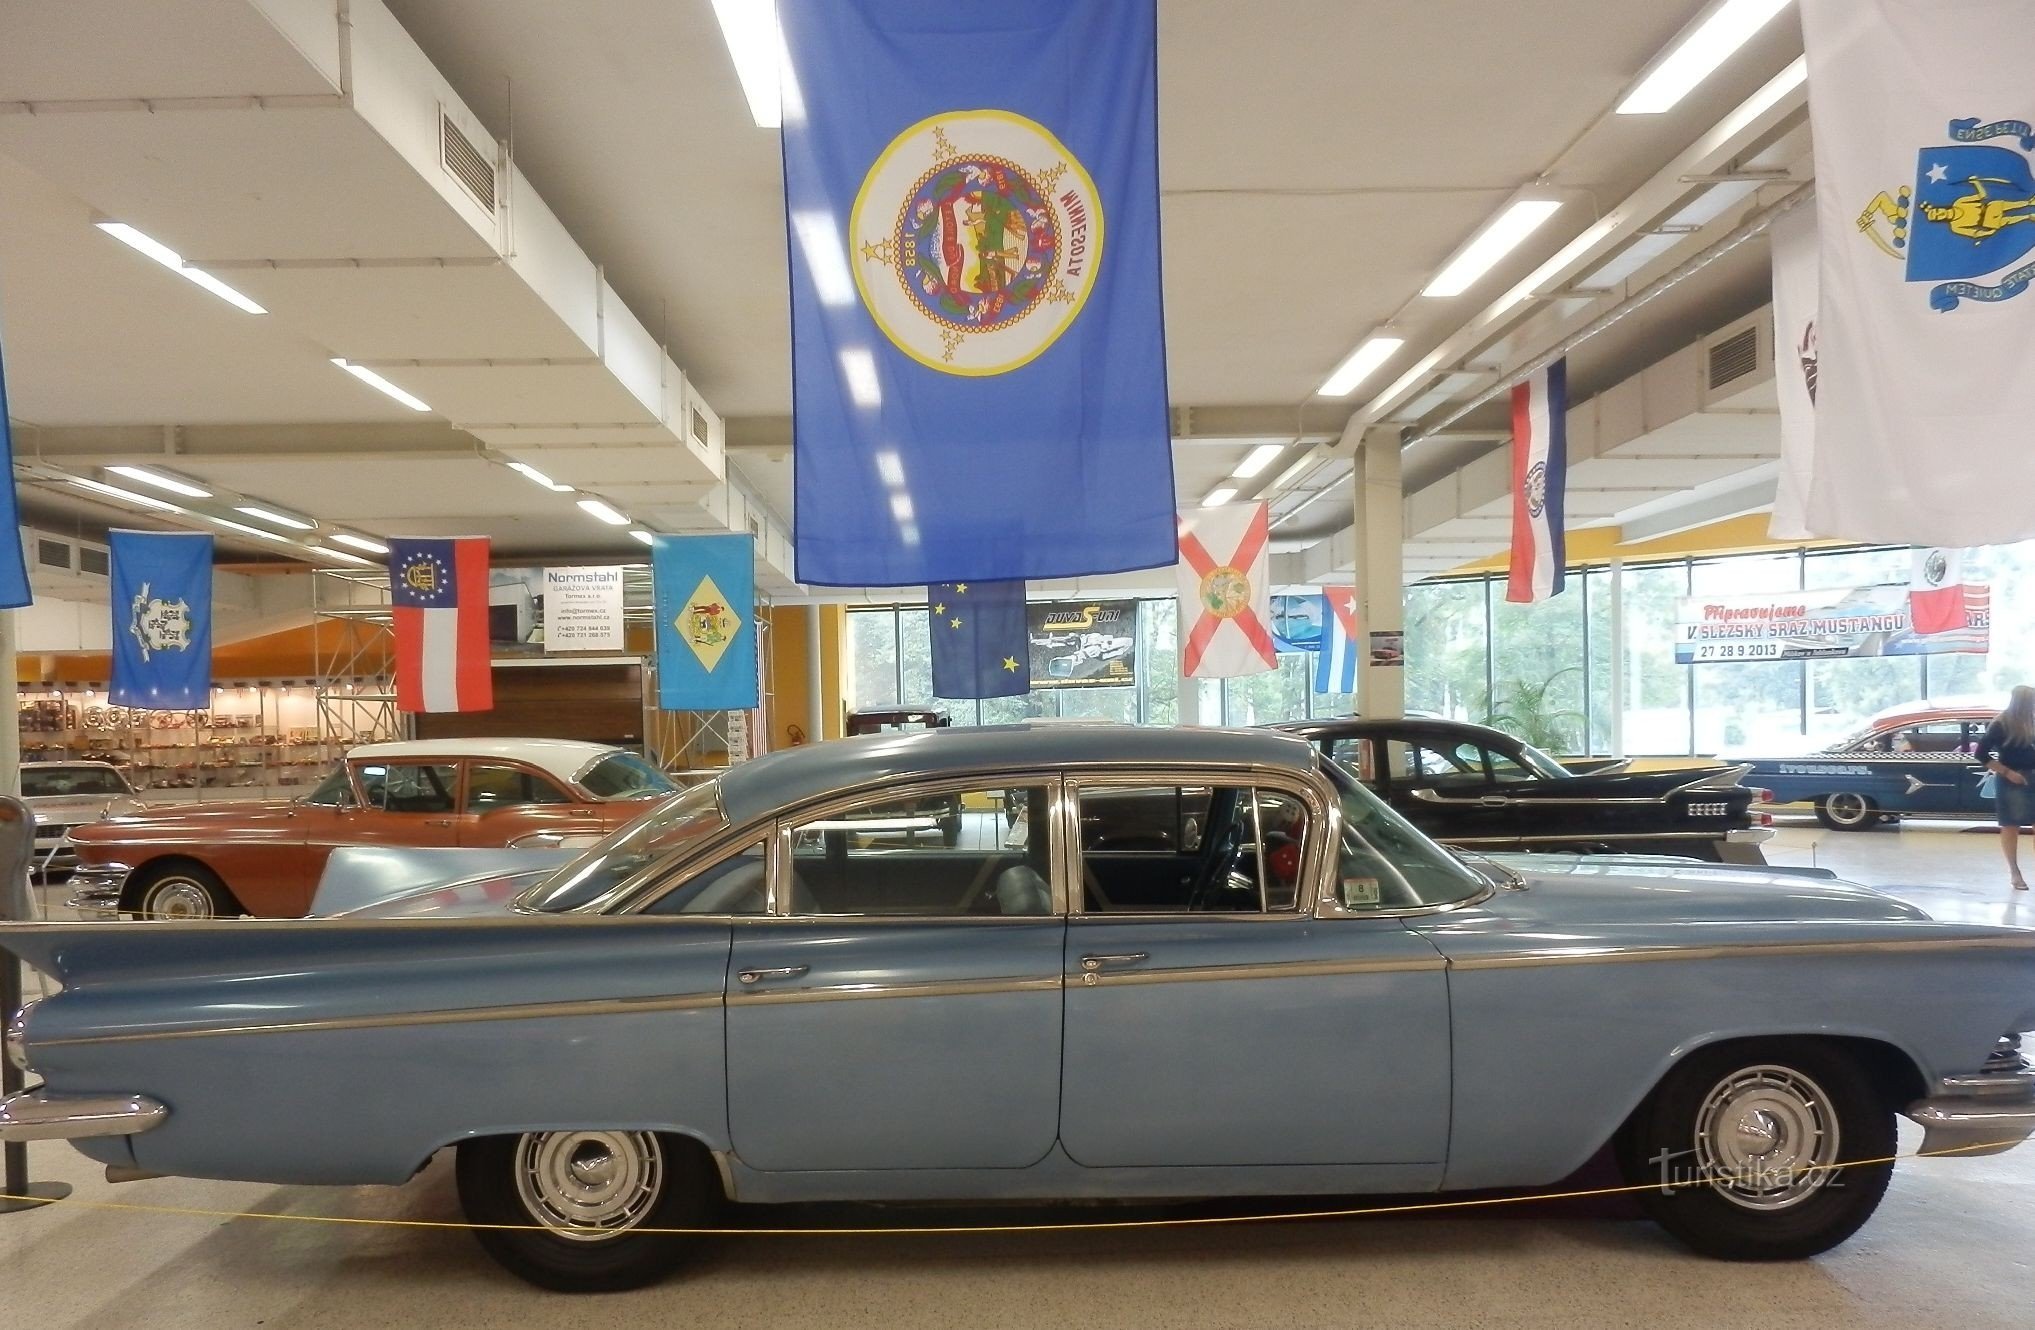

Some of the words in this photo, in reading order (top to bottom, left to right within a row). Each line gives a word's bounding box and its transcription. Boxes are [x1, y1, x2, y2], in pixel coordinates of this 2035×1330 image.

[548, 572, 618, 582] Normstahl
[1703, 604, 1806, 623] Připravujeme
[1813, 616, 1904, 635] MUSTANGU
